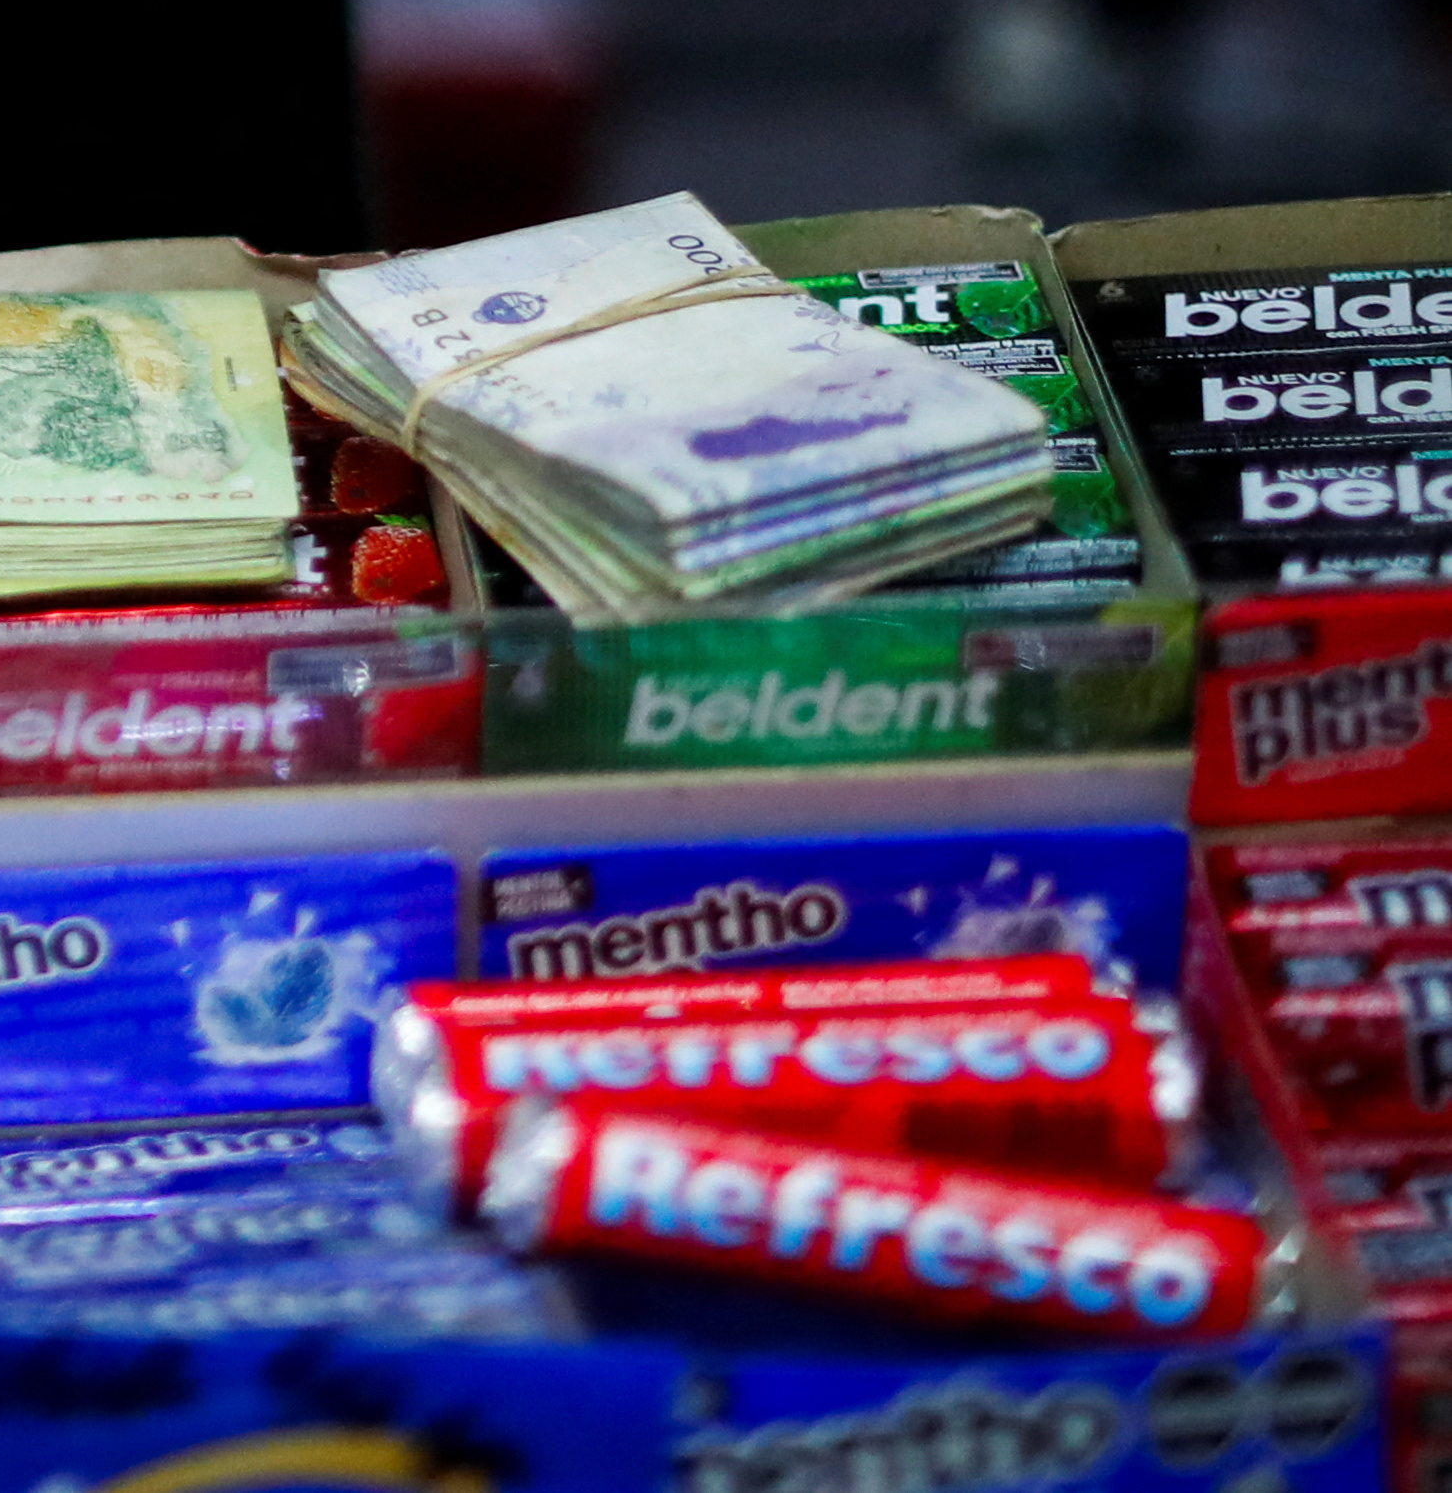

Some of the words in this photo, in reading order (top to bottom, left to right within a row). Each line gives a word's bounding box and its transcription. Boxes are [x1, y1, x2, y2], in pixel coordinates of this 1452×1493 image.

[1199, 286, 1306, 303] NUEVO
[1328, 269, 1413, 282] MENTA
[1237, 371, 1347, 386] NUEVO
[1277, 466, 1389, 481] NUEVO
[625, 670, 1000, 745] beldent
[508, 881, 846, 981] mentho
[483, 1017, 1111, 1093] Refresco
[588, 1125, 1216, 1329] Refresco
